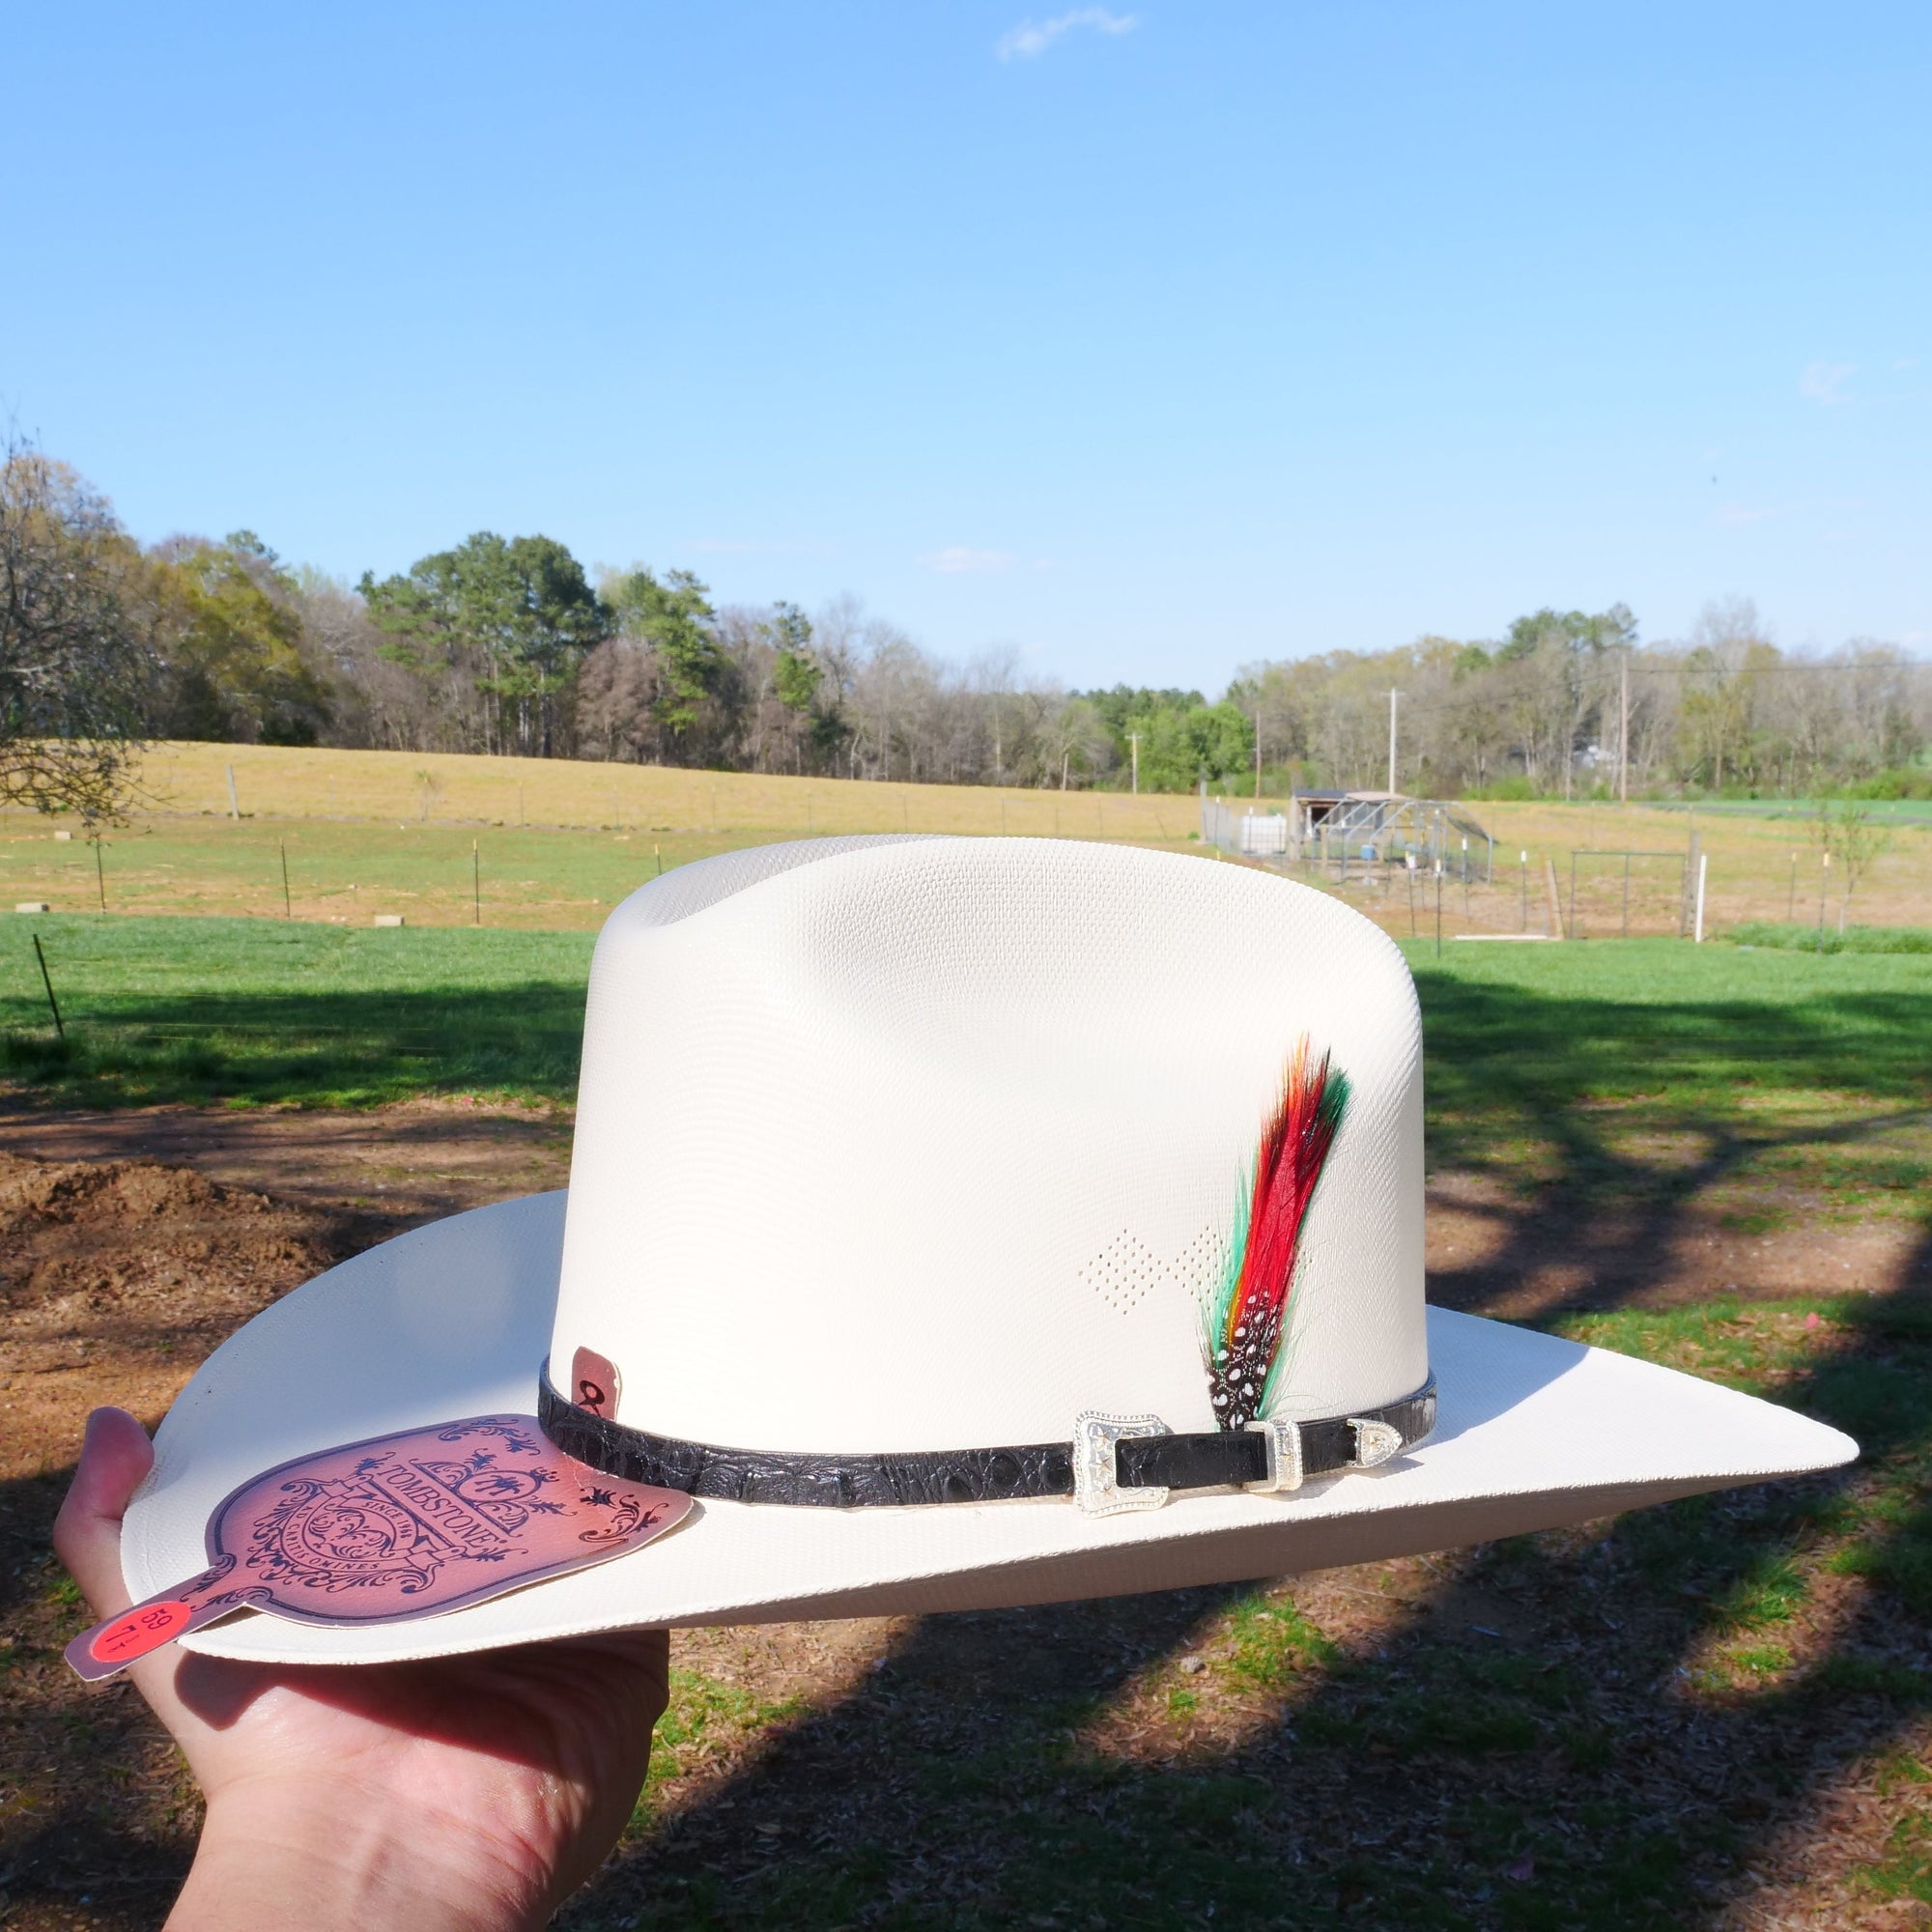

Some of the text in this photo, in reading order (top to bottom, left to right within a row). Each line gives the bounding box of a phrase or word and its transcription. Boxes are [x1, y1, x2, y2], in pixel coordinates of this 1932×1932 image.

[362, 1502, 403, 1519] SINCE
[377, 1464, 497, 1548] TOMBSTONE
[286, 1505, 381, 1570] AD CAPITIS OMINES
[141, 1608, 172, 1630] 59
